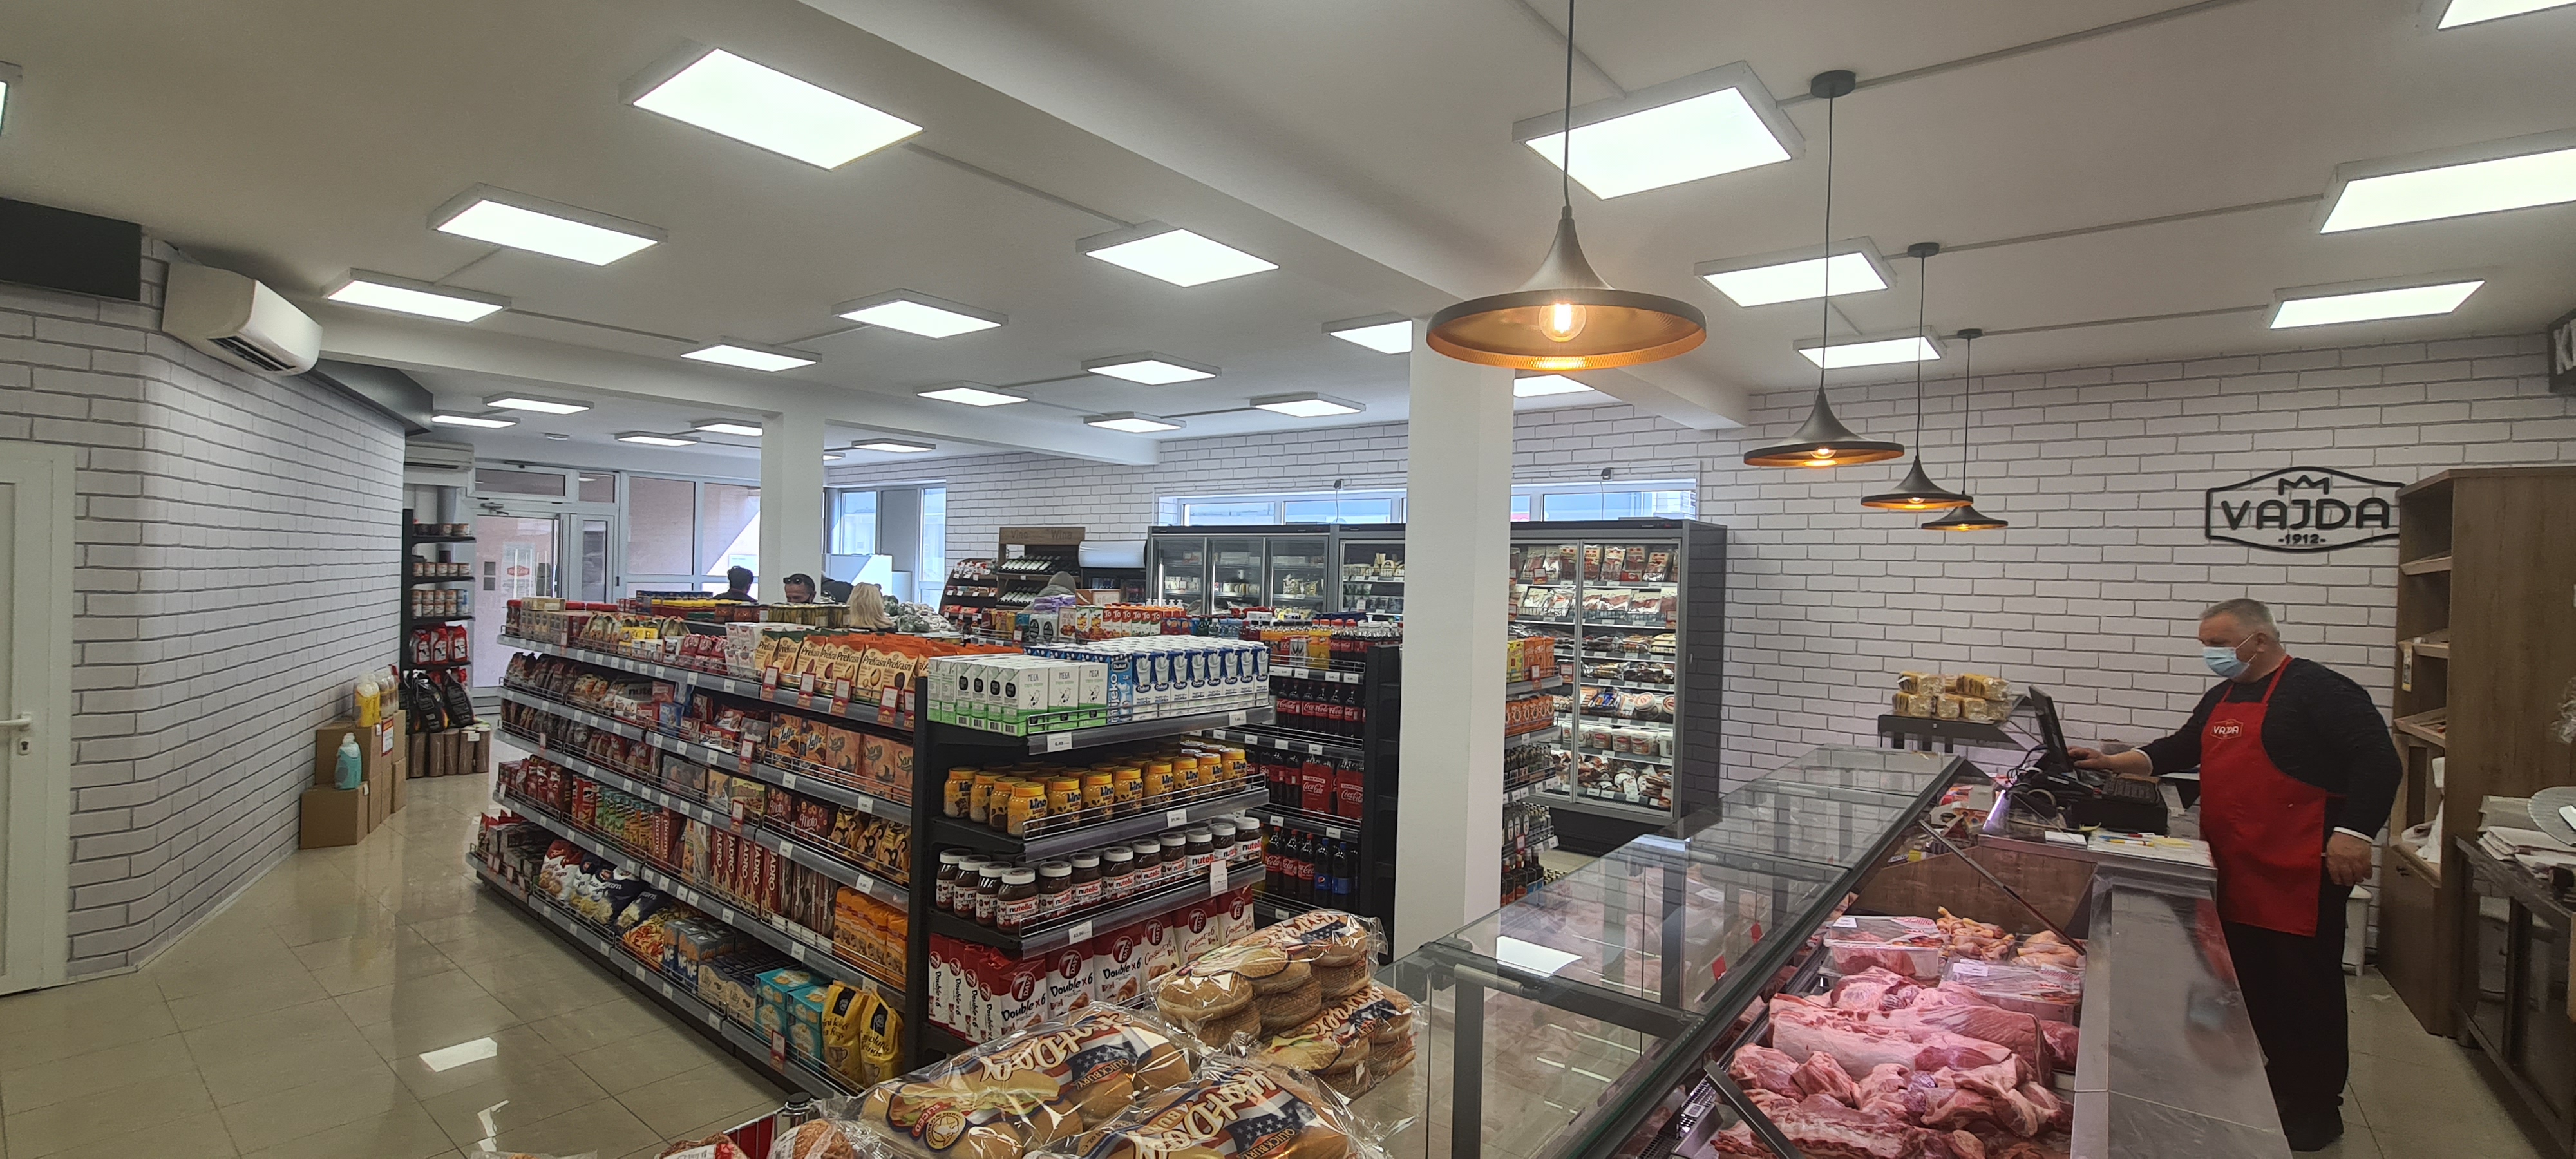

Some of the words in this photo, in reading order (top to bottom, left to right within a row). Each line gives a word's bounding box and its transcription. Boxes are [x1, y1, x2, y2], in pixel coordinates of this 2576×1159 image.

[2221, 497, 2390, 530] VAJDA
[1233, 760, 1247, 771] Lino
[1186, 770, 1198, 781] Lino
[1101, 785, 1114, 796] Lino
[1130, 780, 1143, 792] Lino
[1030, 798, 1047, 809] Lino
[1066, 792, 1081, 804] Lino
[754, 842, 762, 885] JADRO
[1078, 885, 1098, 895] nutella
[1115, 878, 1133, 888] nutella
[1009, 903, 1033, 913] nutella
[1231, 900, 1239, 918] 7
[1190, 912, 1199, 932] 7
[1148, 923, 1157, 944] 7
[1115, 939, 1126, 962] 7
[1122, 940, 1132, 960] DAYS
[1062, 954, 1074, 977] 7
[1070, 954, 1079, 975] DAYS
[1103, 963, 1130, 979] Double
[1014, 974, 1026, 1000] 7
[1023, 975, 1032, 997] DAYS
[1050, 978, 1081, 997] Double
[1001, 1000, 1034, 1022] Double
[1077, 1058, 1130, 1091] QUICKBURY
[914, 1103, 941, 1132] SLICED
